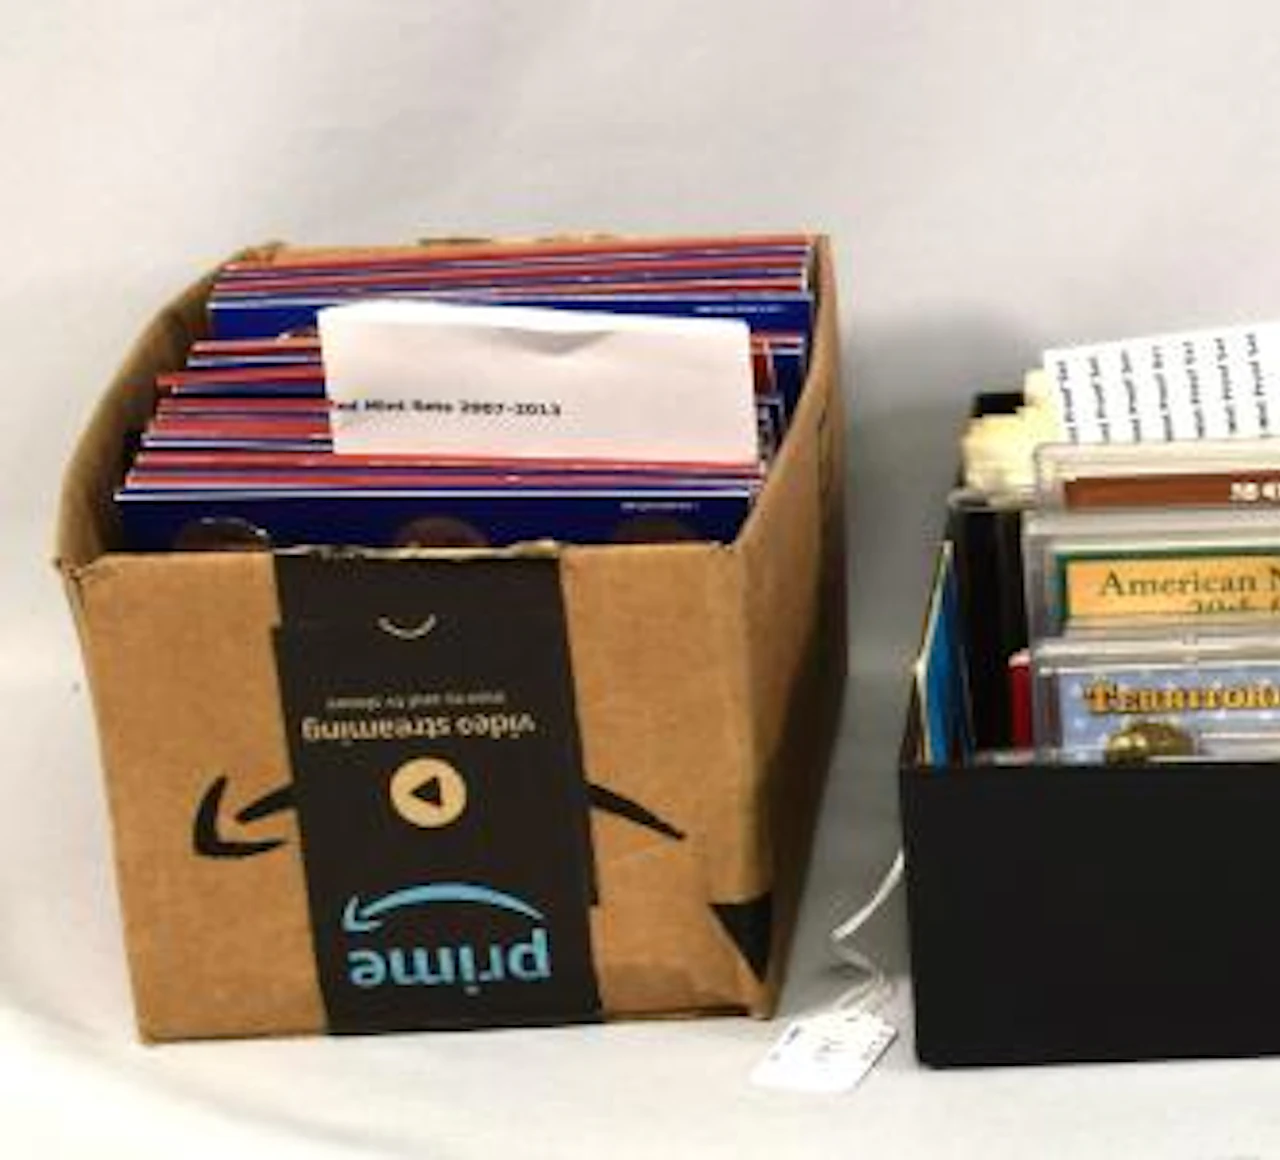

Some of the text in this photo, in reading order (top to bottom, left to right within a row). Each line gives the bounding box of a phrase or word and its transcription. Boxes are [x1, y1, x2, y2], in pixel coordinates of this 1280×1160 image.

[1099, 567, 1257, 598] American
[301, 711, 538, 746] video streaming
[346, 927, 552, 997] prime
